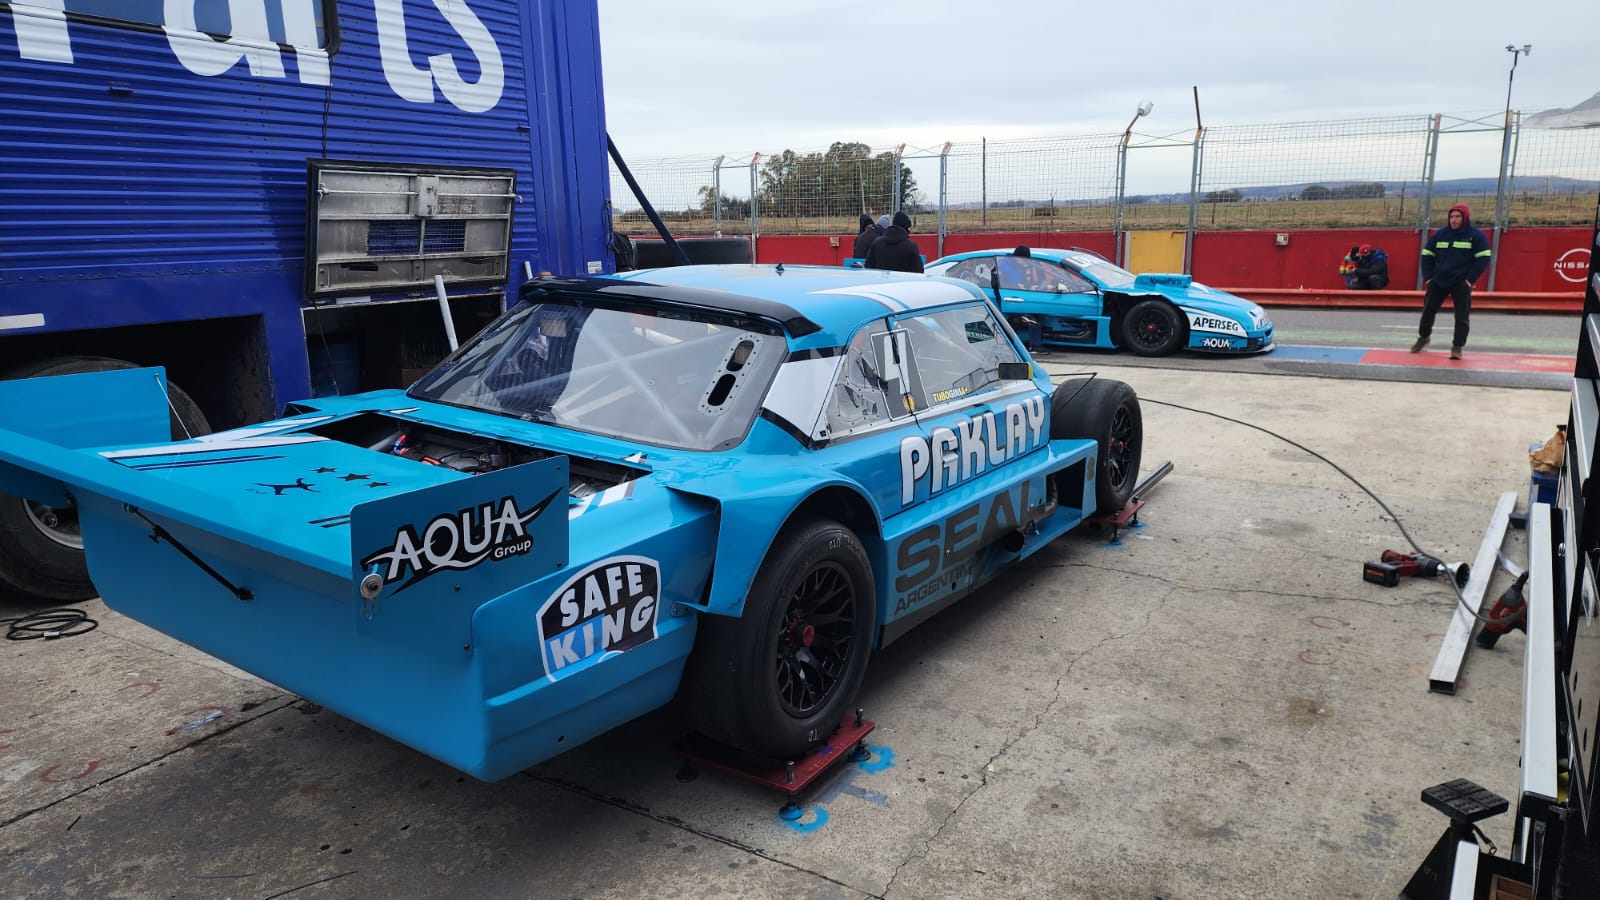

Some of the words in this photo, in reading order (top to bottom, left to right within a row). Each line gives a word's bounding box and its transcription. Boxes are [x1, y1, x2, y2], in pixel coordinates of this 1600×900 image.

[1193, 316, 1239, 332] APERSEG
[900, 395, 1045, 506] PAKLAY
[370, 498, 533, 581] AQUA
[494, 540, 532, 559] Group
[895, 480, 1047, 593] SEAL
[550, 595, 655, 670] KING
[560, 564, 643, 627] SAFE
